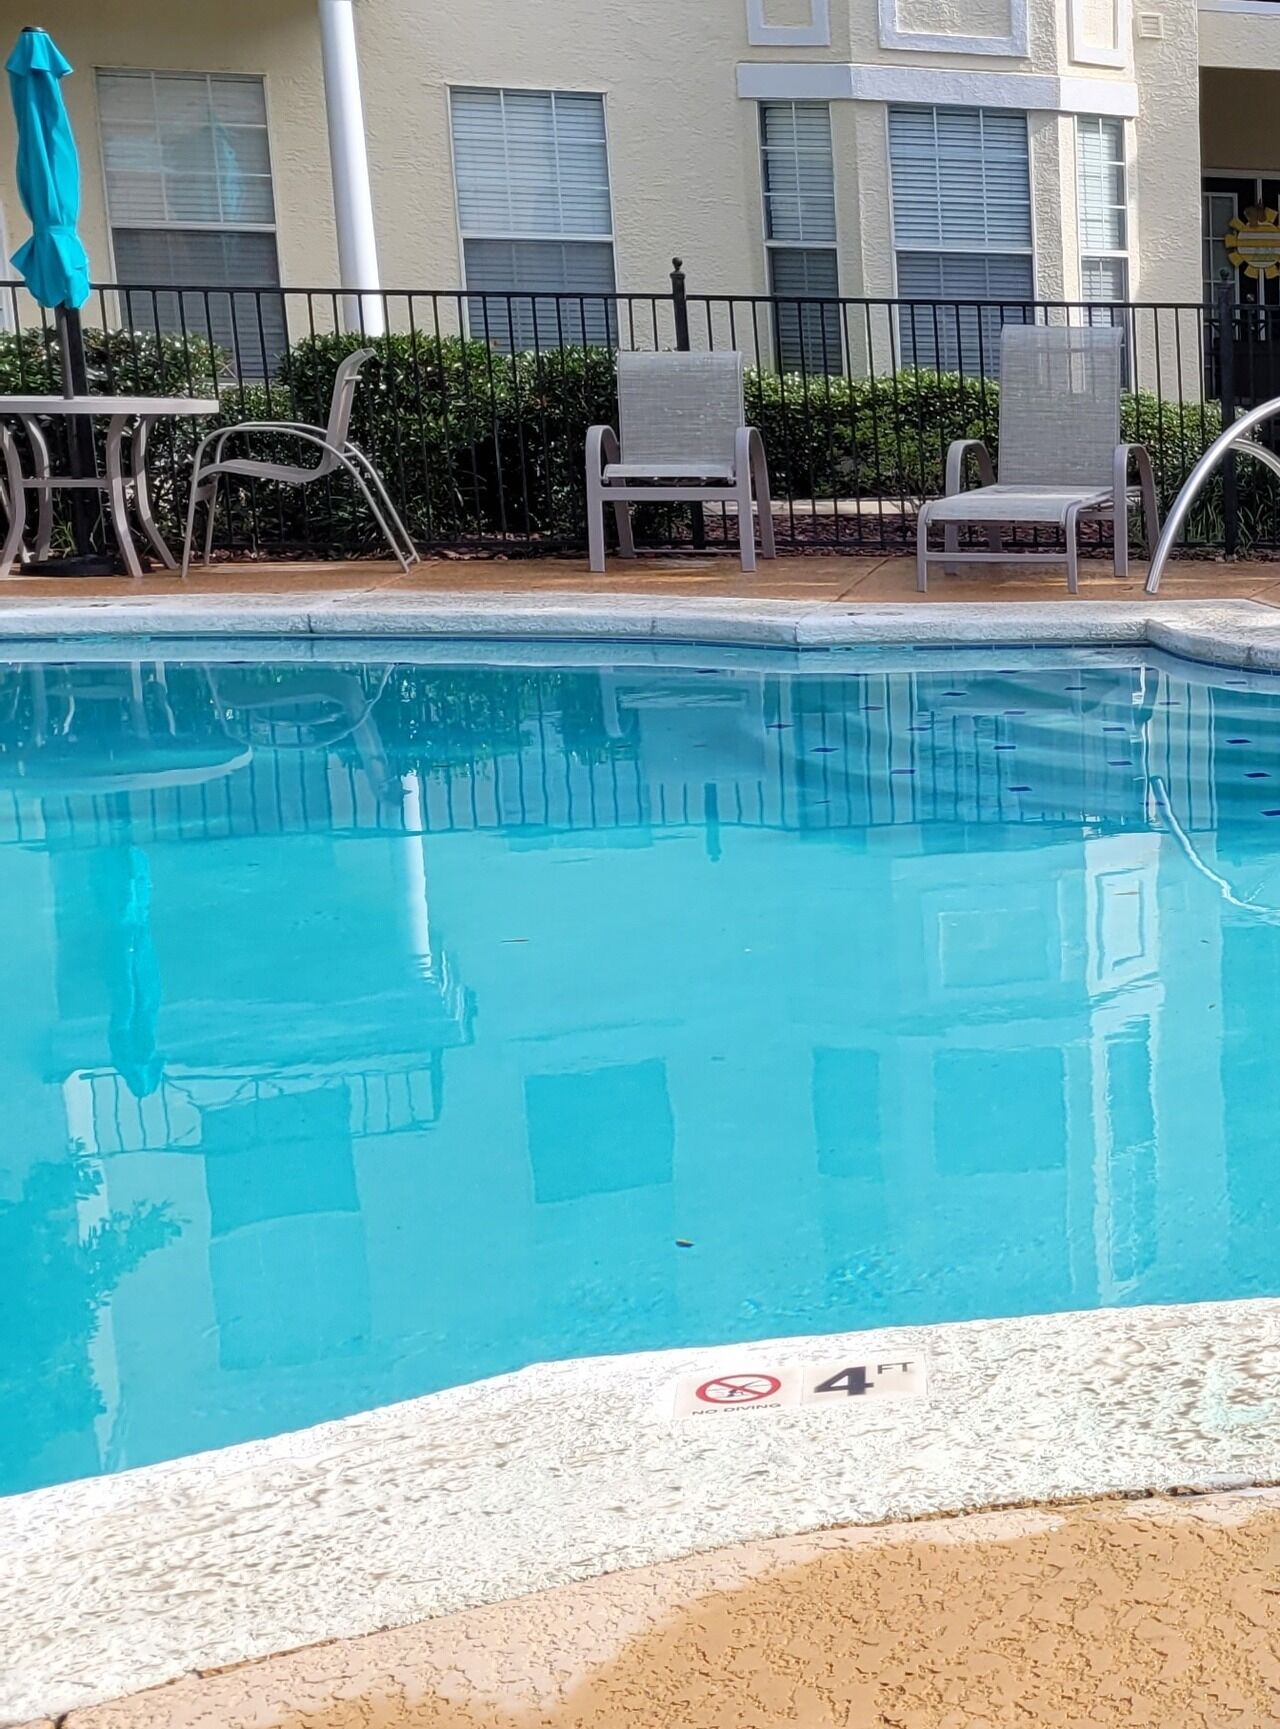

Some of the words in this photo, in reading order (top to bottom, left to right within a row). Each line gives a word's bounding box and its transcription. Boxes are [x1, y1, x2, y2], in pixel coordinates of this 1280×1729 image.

[814, 1366, 874, 1396] 4
[877, 1361, 914, 1375] FT
[723, 1403, 781, 1412] DIVING
